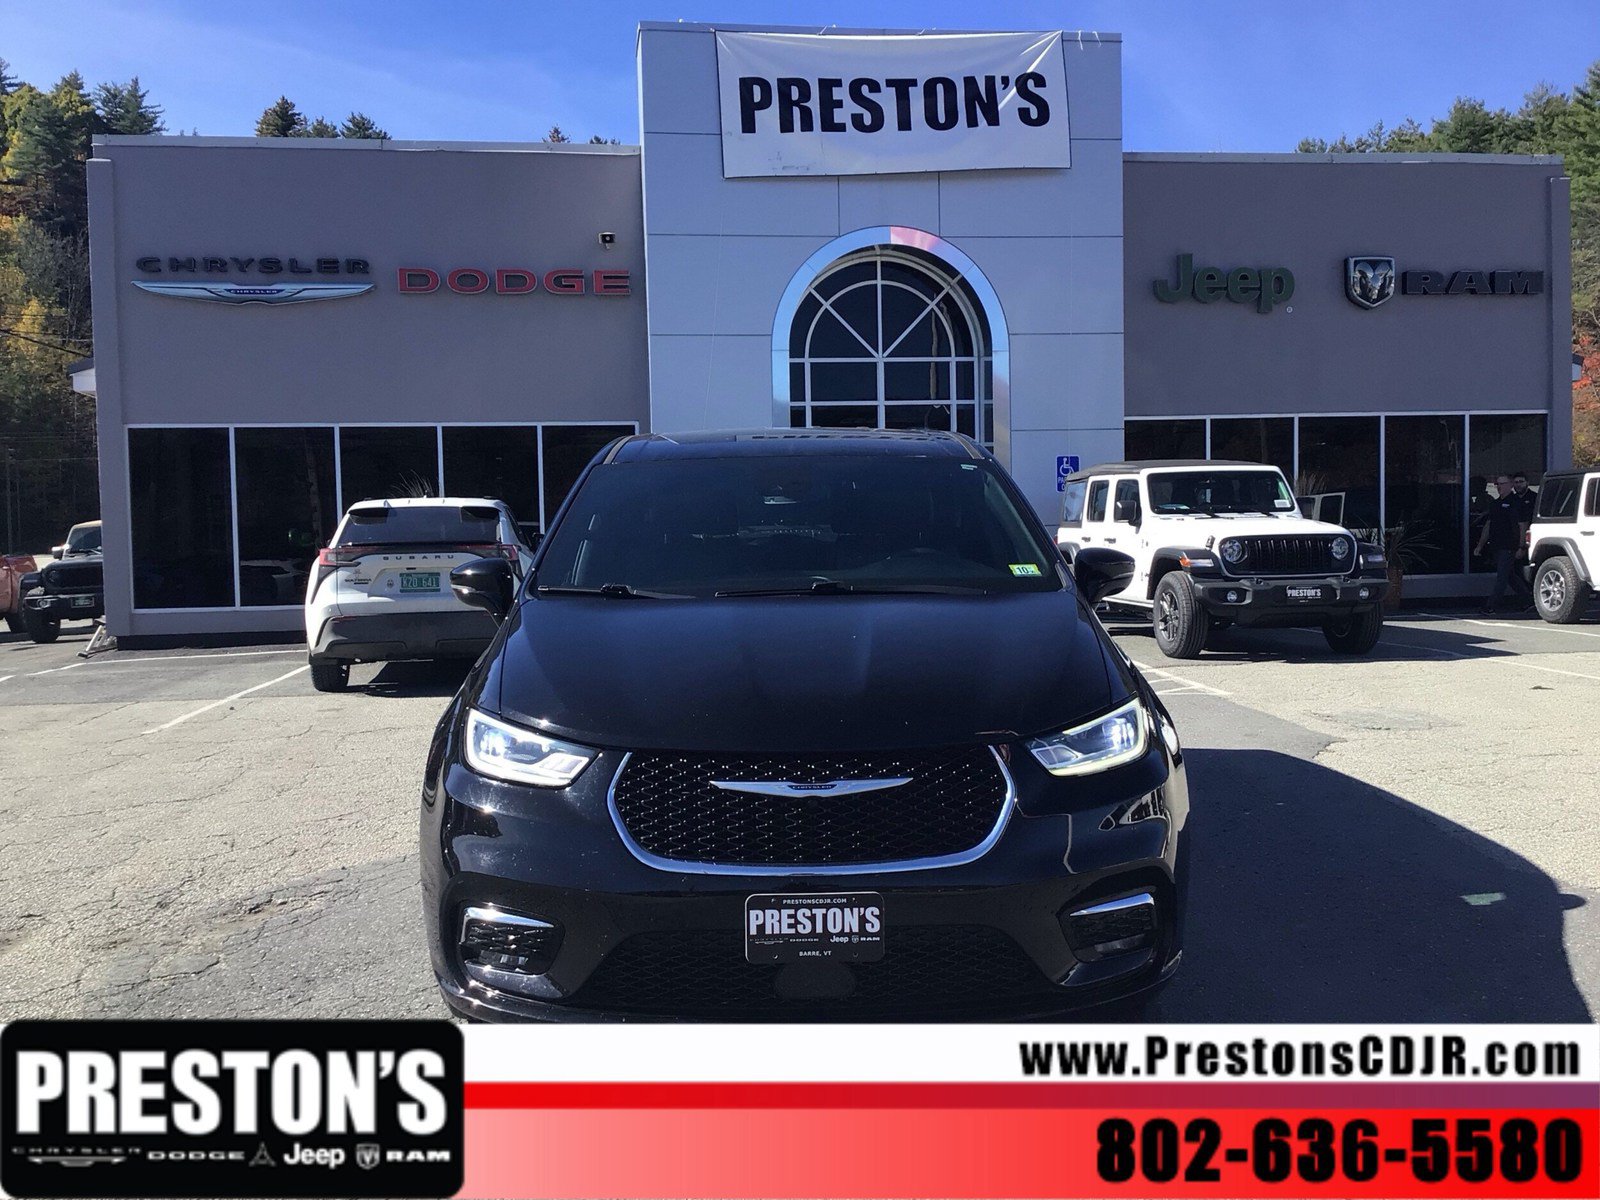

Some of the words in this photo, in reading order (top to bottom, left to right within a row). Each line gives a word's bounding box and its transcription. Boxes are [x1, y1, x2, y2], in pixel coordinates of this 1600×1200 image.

[738, 71, 1050, 133] PRESTON'S
[135, 256, 370, 274] CHRYSLER
[397, 268, 631, 296] DODGE
[1153, 253, 1295, 314] Jeep
[1402, 269, 1544, 295] RAM
[422, 577, 437, 588] 641
[1286, 589, 1321, 597] PRESTON'S
[749, 906, 881, 935] PRESTON'S
[830, 935, 849, 944] Jeep
